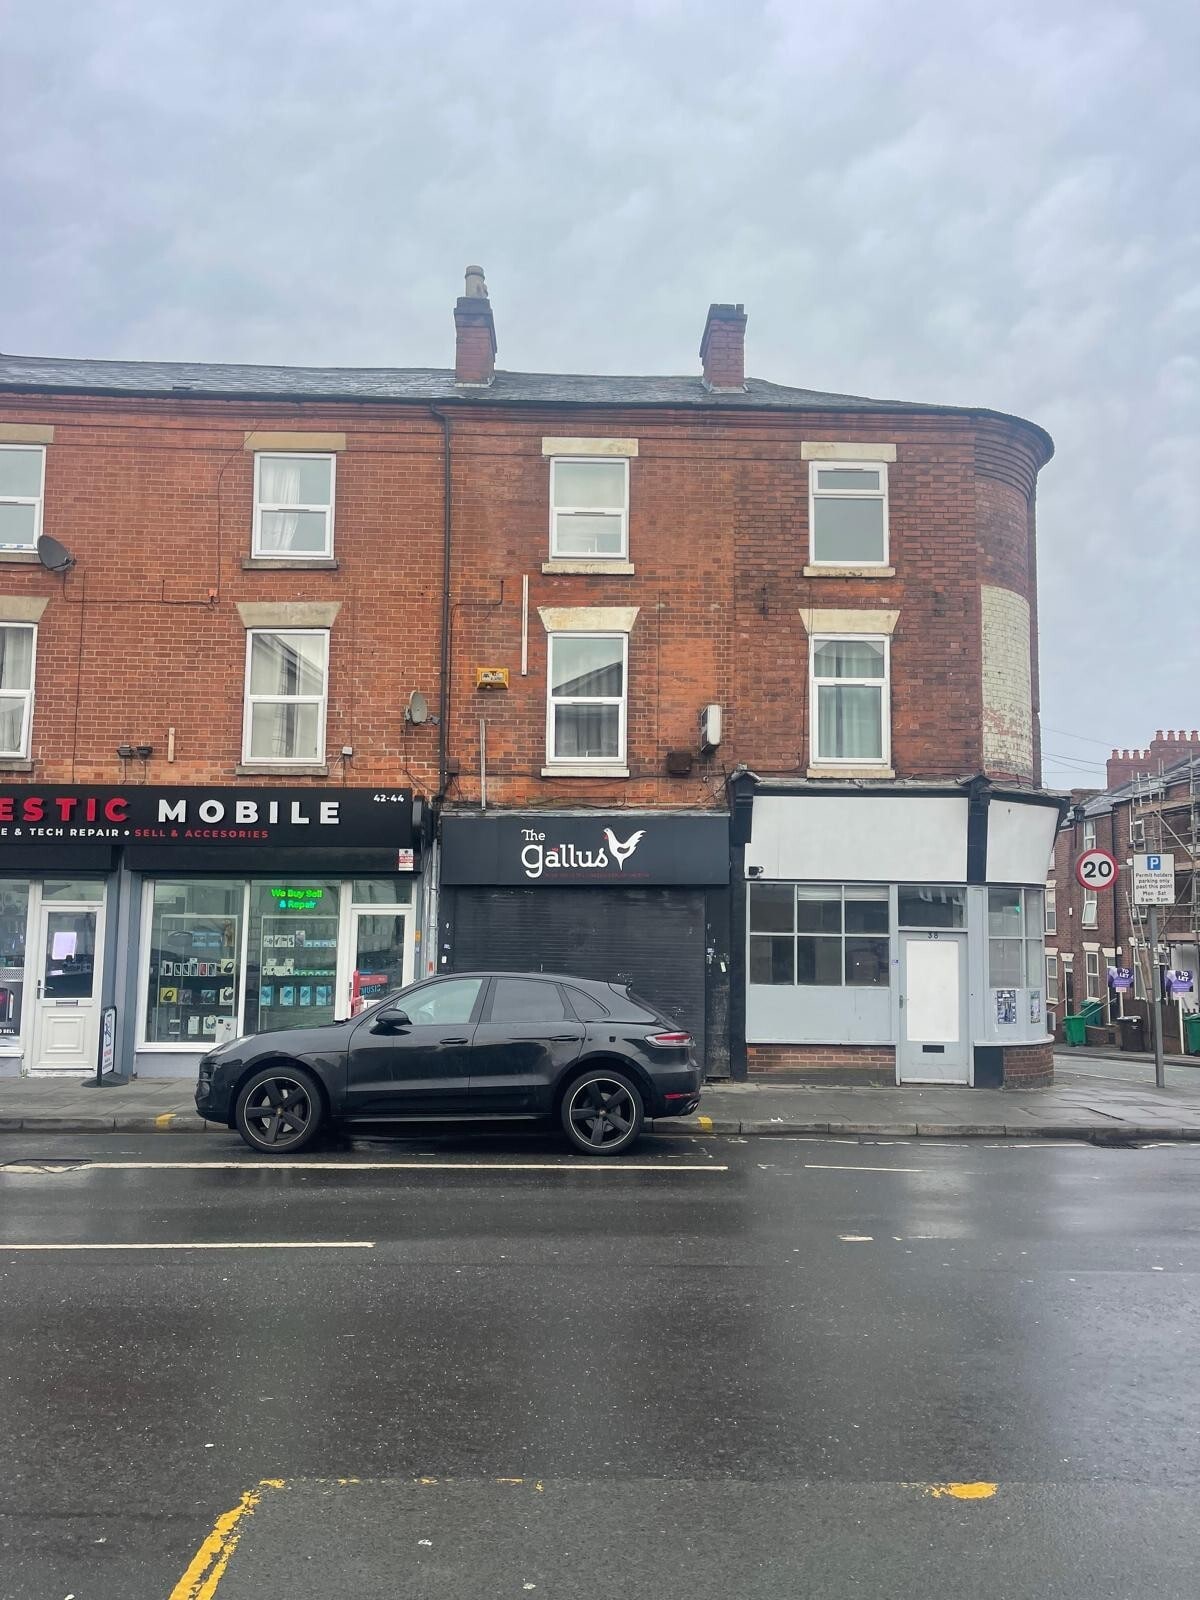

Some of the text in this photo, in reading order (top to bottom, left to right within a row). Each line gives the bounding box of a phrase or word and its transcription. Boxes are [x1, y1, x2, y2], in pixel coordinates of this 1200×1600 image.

[373, 794, 405, 803] 42-44
[158, 799, 340, 824] MOBILE
[14, 828, 22, 836] &
[30, 828, 64, 836] TECH
[70, 828, 119, 837] REPAIR
[134, 829, 166, 838] SELL
[171, 830, 179, 838] &
[185, 829, 269, 839] ACCESORIES
[521, 829, 546, 841] The
[521, 844, 609, 878] gallus
[1150, 857, 1159, 869] P
[1083, 860, 1112, 878] 20
[287, 900, 317, 910] Repair
[927, 931, 939, 939] 38
